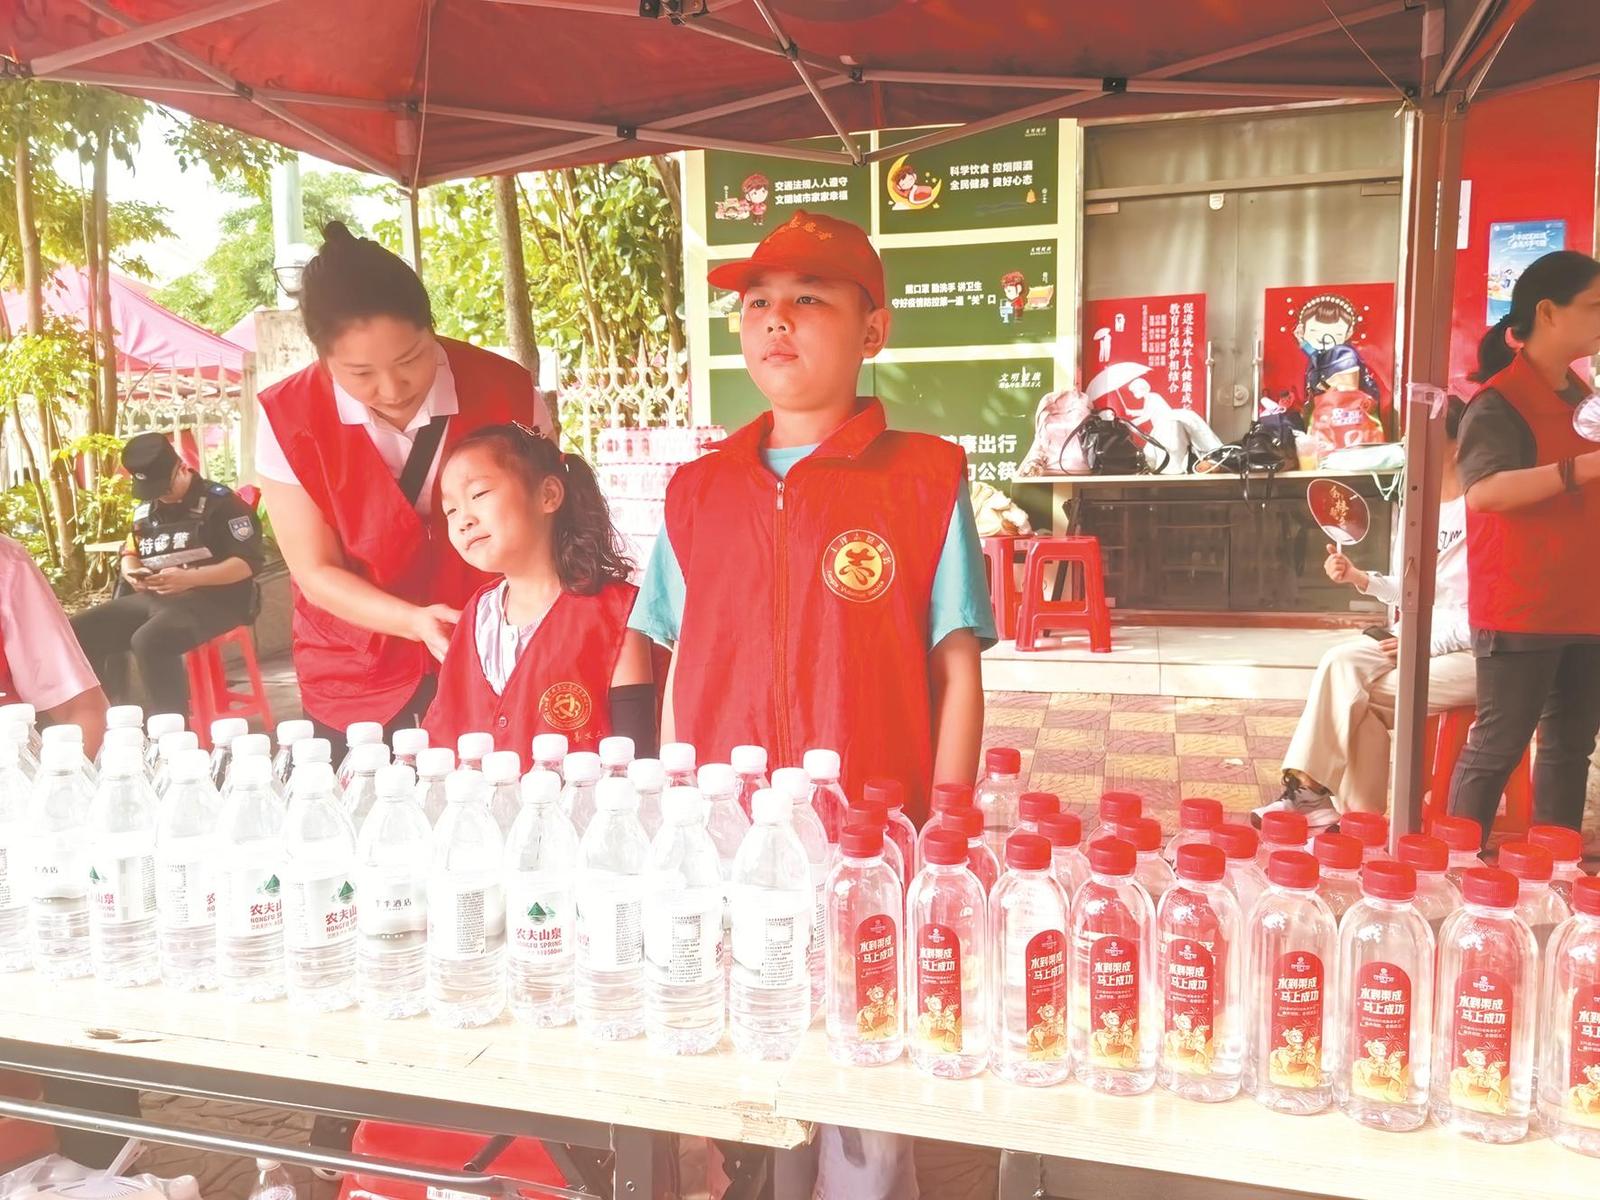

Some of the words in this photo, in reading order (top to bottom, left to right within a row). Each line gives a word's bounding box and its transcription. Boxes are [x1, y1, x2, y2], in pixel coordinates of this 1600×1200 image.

[949, 163, 990, 176] 科学饮食
[992, 160, 1033, 173] 控烟限酒
[774, 176, 848, 192] 交通法规人人遵守
[949, 178, 990, 191] 全民健身
[992, 175, 1033, 188] 良好心态
[775, 190, 848, 205] 文明城市家家幸福
[957, 281, 982, 292] 讲卫生
[1168, 303, 1180, 394] 教育与保护相结合
[516, 927, 562, 941] 农夫山泉
[1033, 964, 1065, 981] 马上成功
[1097, 974, 1133, 987] 马上成功
[1171, 976, 1208, 990] 马上成功
[1280, 990, 1319, 1003] 马上成功
[1363, 1003, 1405, 1015] 马上成功
[1461, 1009, 1506, 1025] 马上成功
